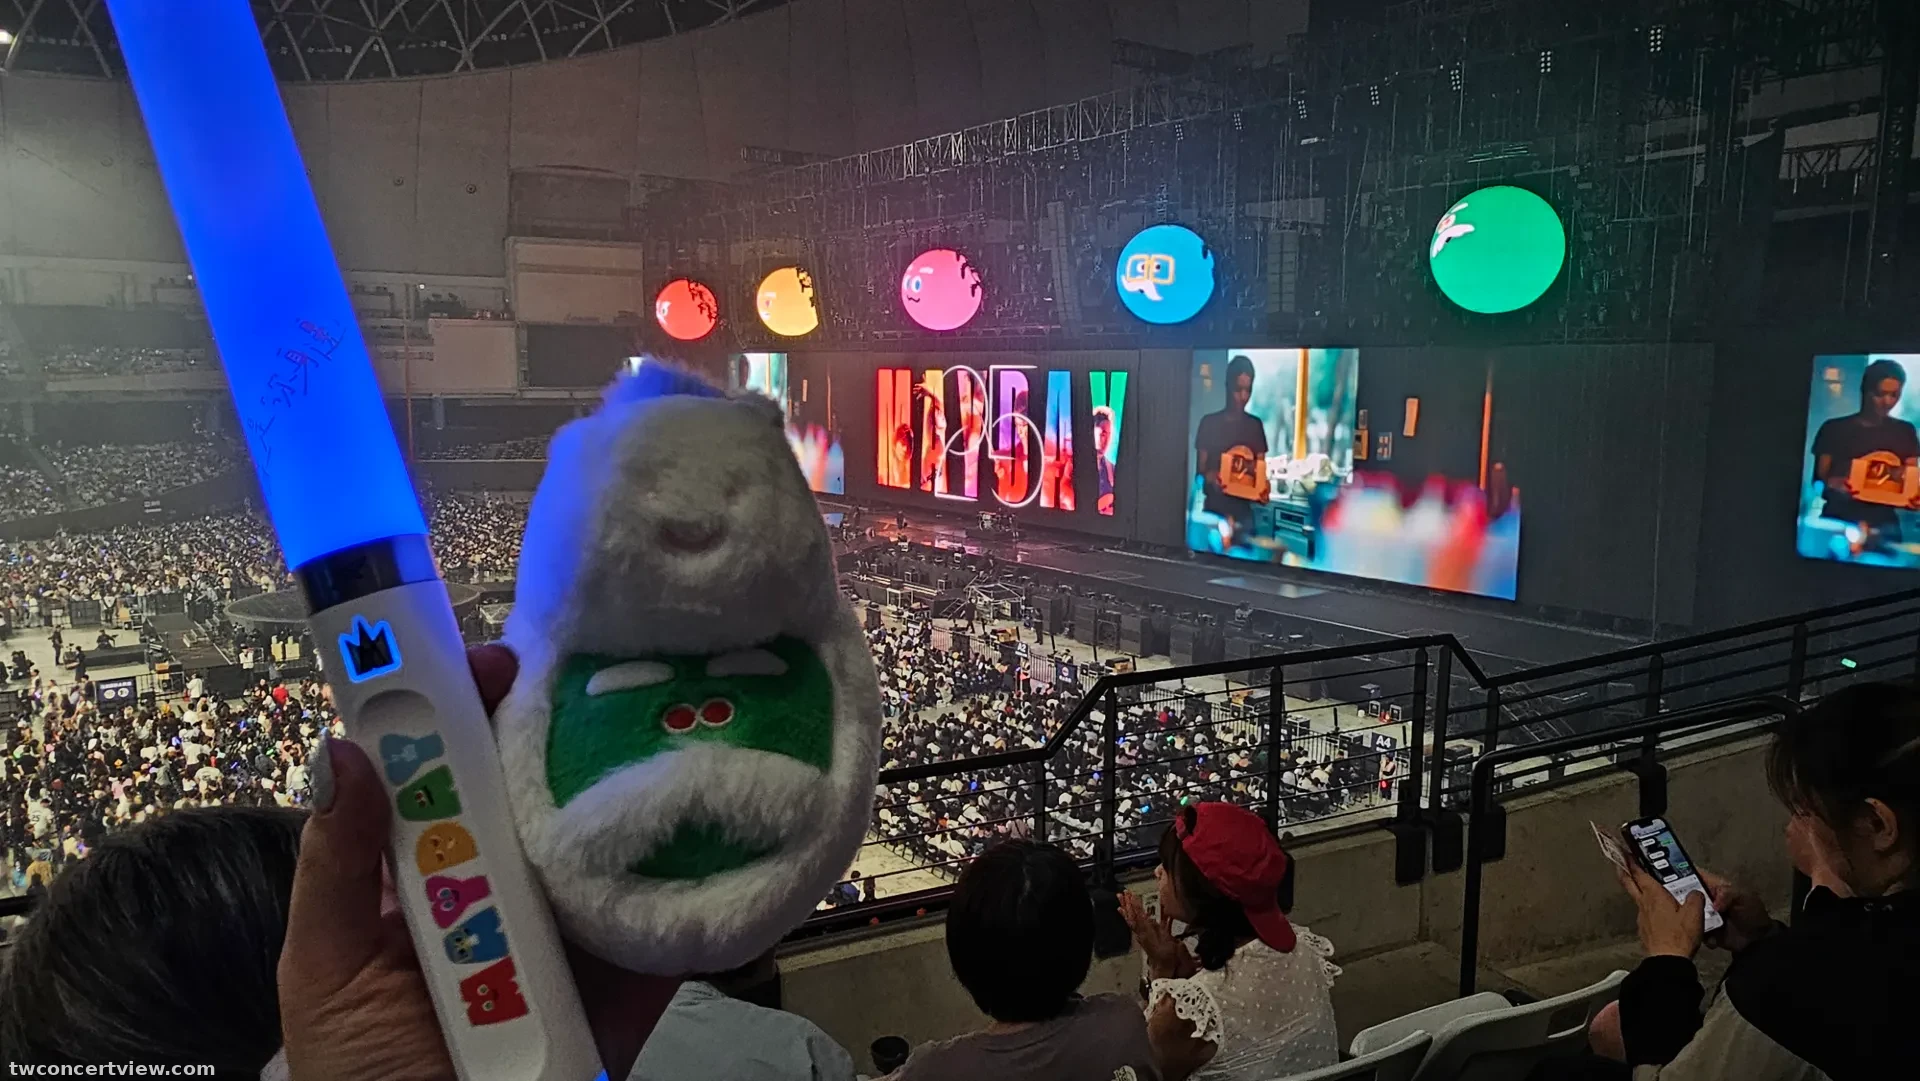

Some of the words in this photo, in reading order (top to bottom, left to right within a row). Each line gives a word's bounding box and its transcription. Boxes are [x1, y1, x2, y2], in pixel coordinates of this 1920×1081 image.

[877, 367, 1128, 516] MAYDAY
[934, 364, 1044, 508] 25
[1017, 641, 1027, 653] A2
[1375, 735, 1391, 748] A4
